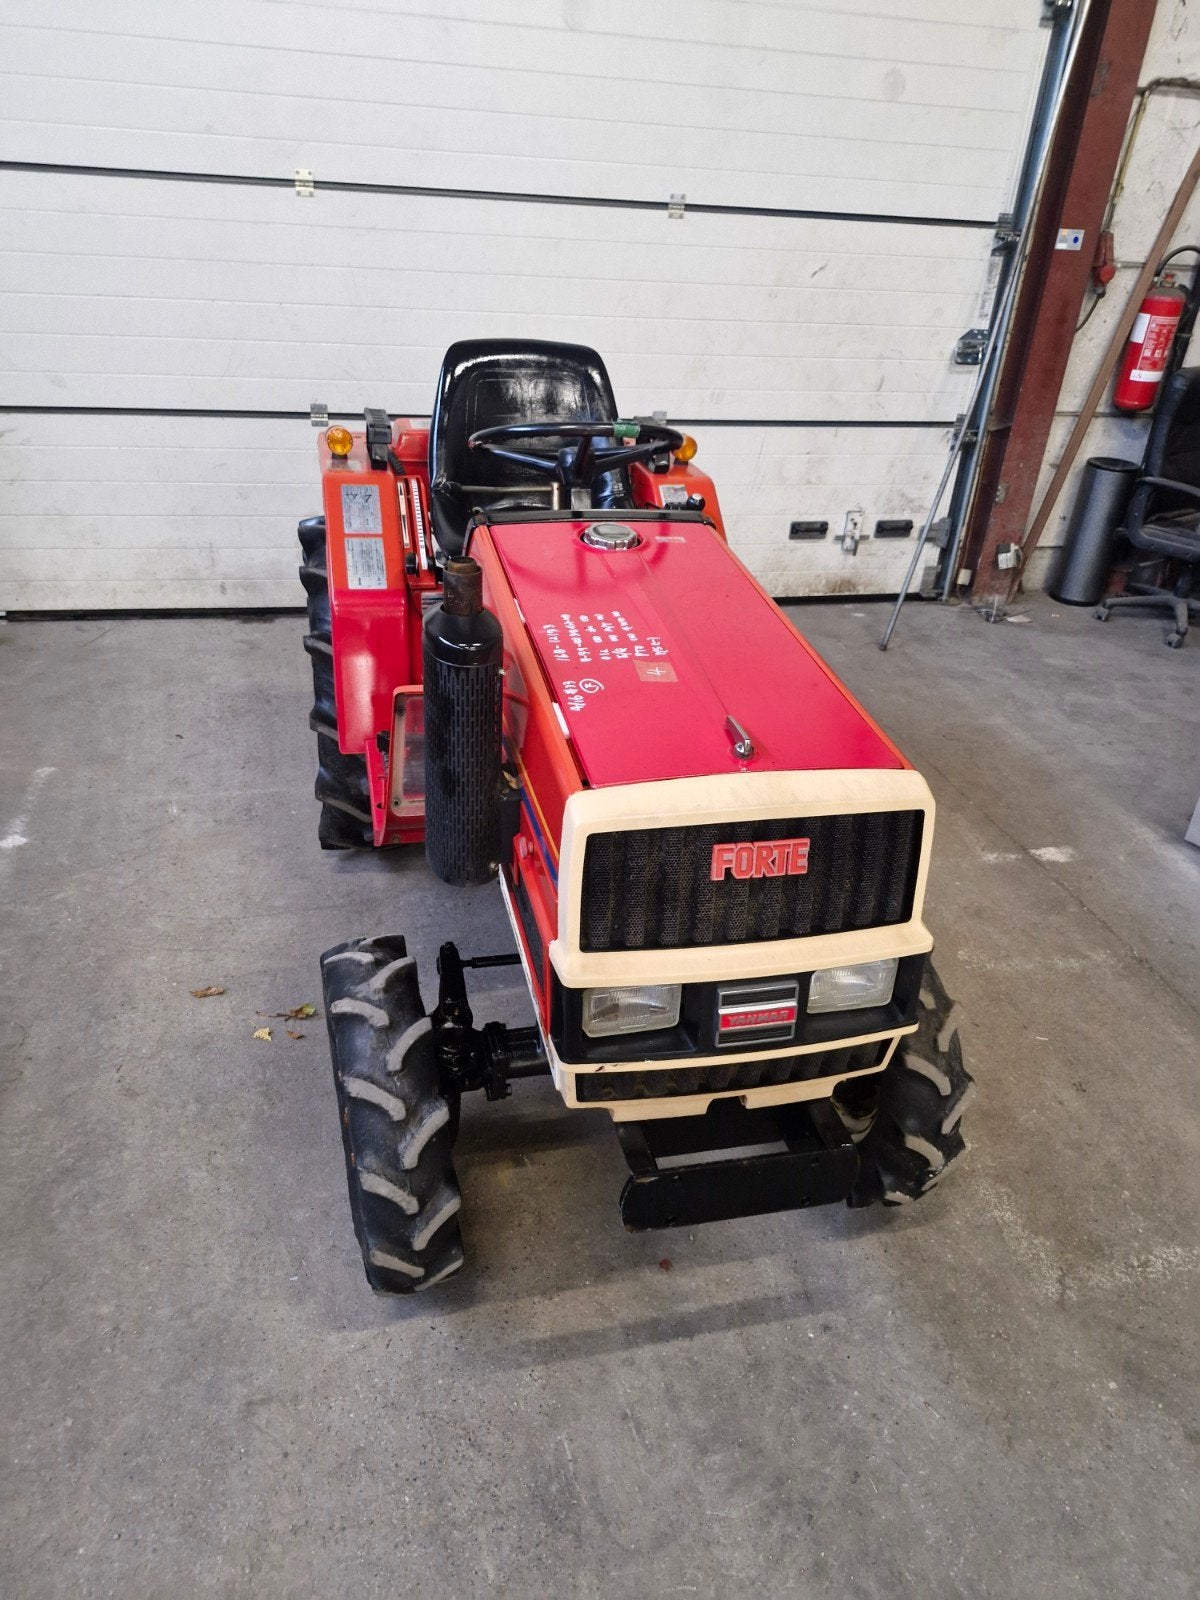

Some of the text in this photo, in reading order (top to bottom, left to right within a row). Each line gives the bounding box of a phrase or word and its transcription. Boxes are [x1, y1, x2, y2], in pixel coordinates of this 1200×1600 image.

[646, 667, 666, 676] 4
[710, 837, 811, 881] FORTE
[728, 1009, 790, 1027] YANMAR
